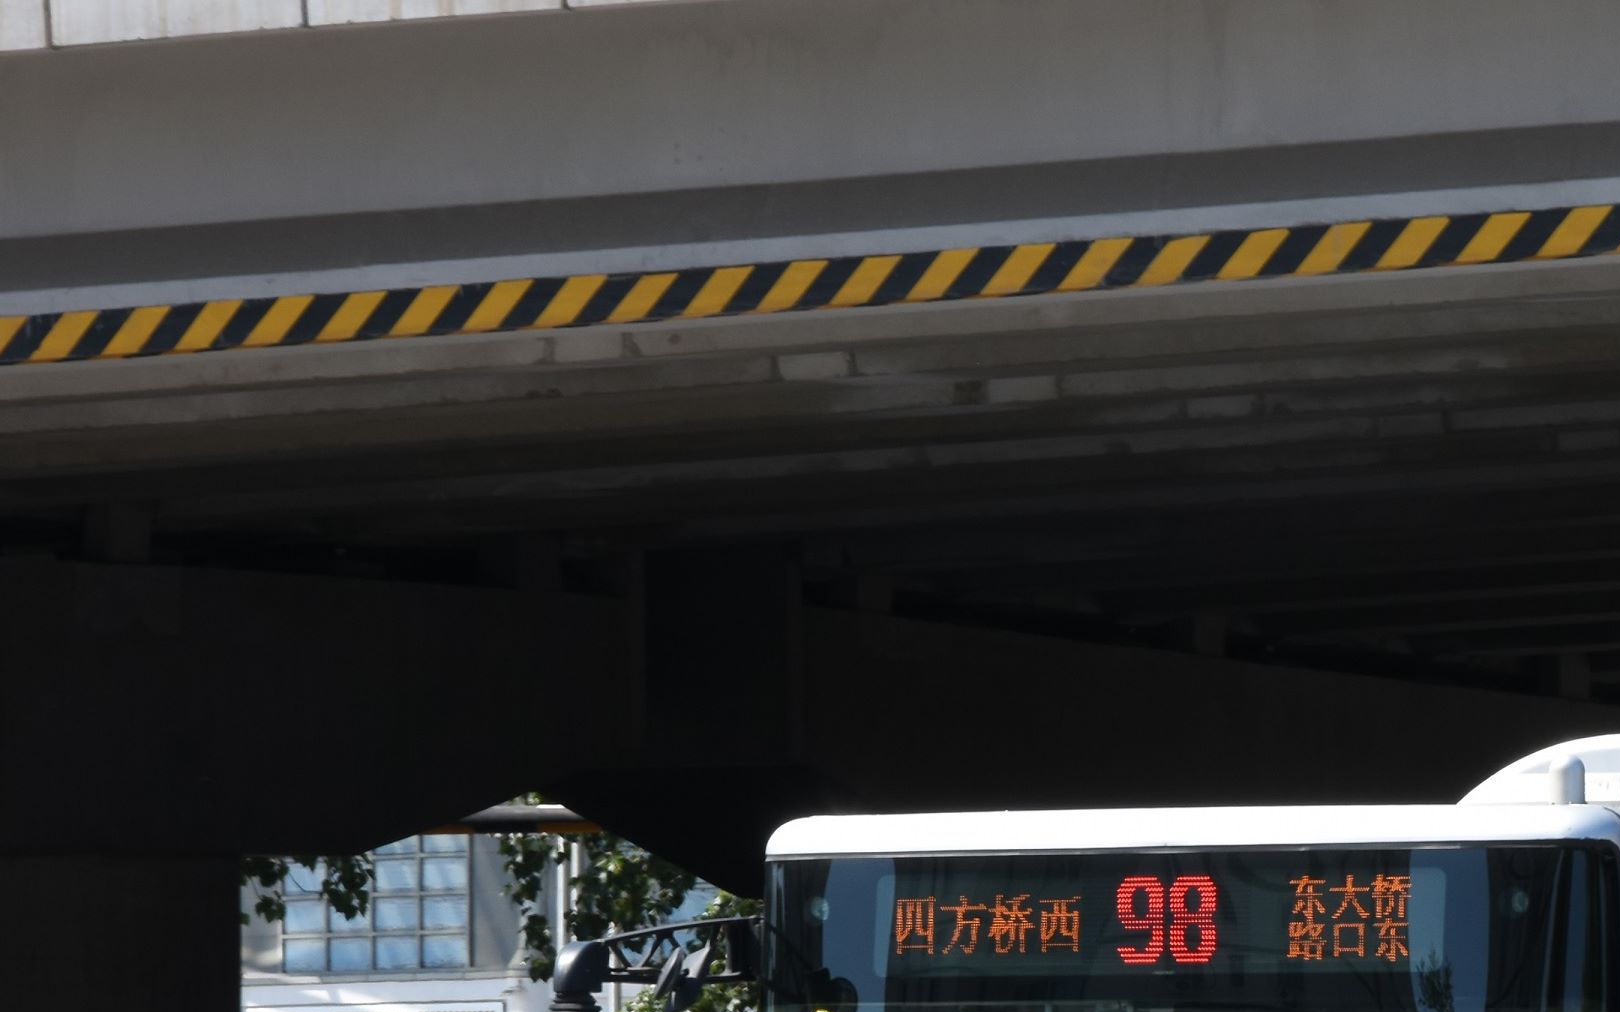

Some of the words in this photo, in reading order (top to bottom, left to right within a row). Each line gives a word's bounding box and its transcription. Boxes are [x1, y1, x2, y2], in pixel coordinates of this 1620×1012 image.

[1116, 875, 1217, 964] 98
[1289, 875, 1412, 919] 东大桥
[896, 894, 1081, 955] 四方桥西
[1286, 919, 1410, 961] 路口东
